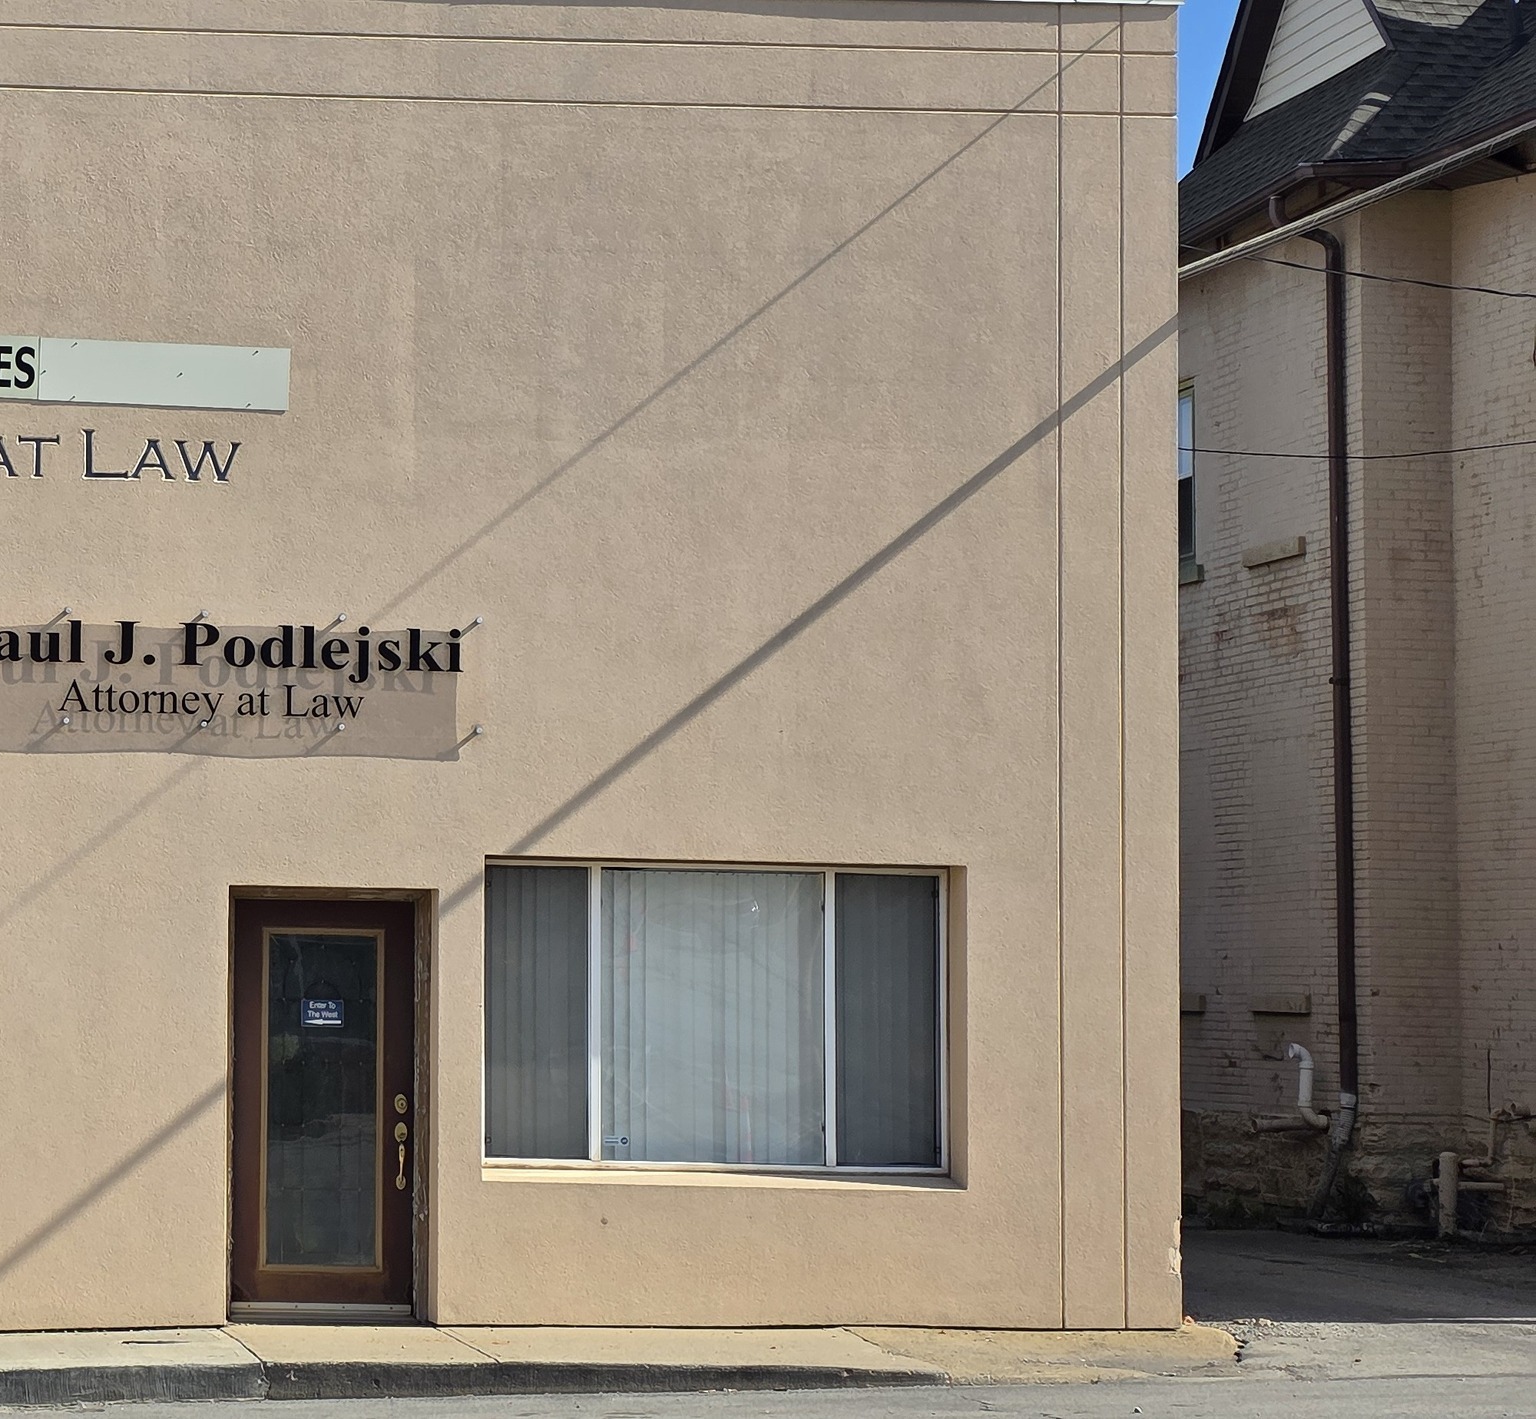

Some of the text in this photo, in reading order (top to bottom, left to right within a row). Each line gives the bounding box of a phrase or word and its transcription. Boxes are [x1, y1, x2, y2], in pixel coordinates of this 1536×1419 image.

[104, 620, 156, 666] J.
[178, 622, 464, 682] Podlejski
[57, 679, 365, 722] Attorney at Law
[307, 1010, 338, 1018] The West
[309, 1001, 337, 1010] Enter To
